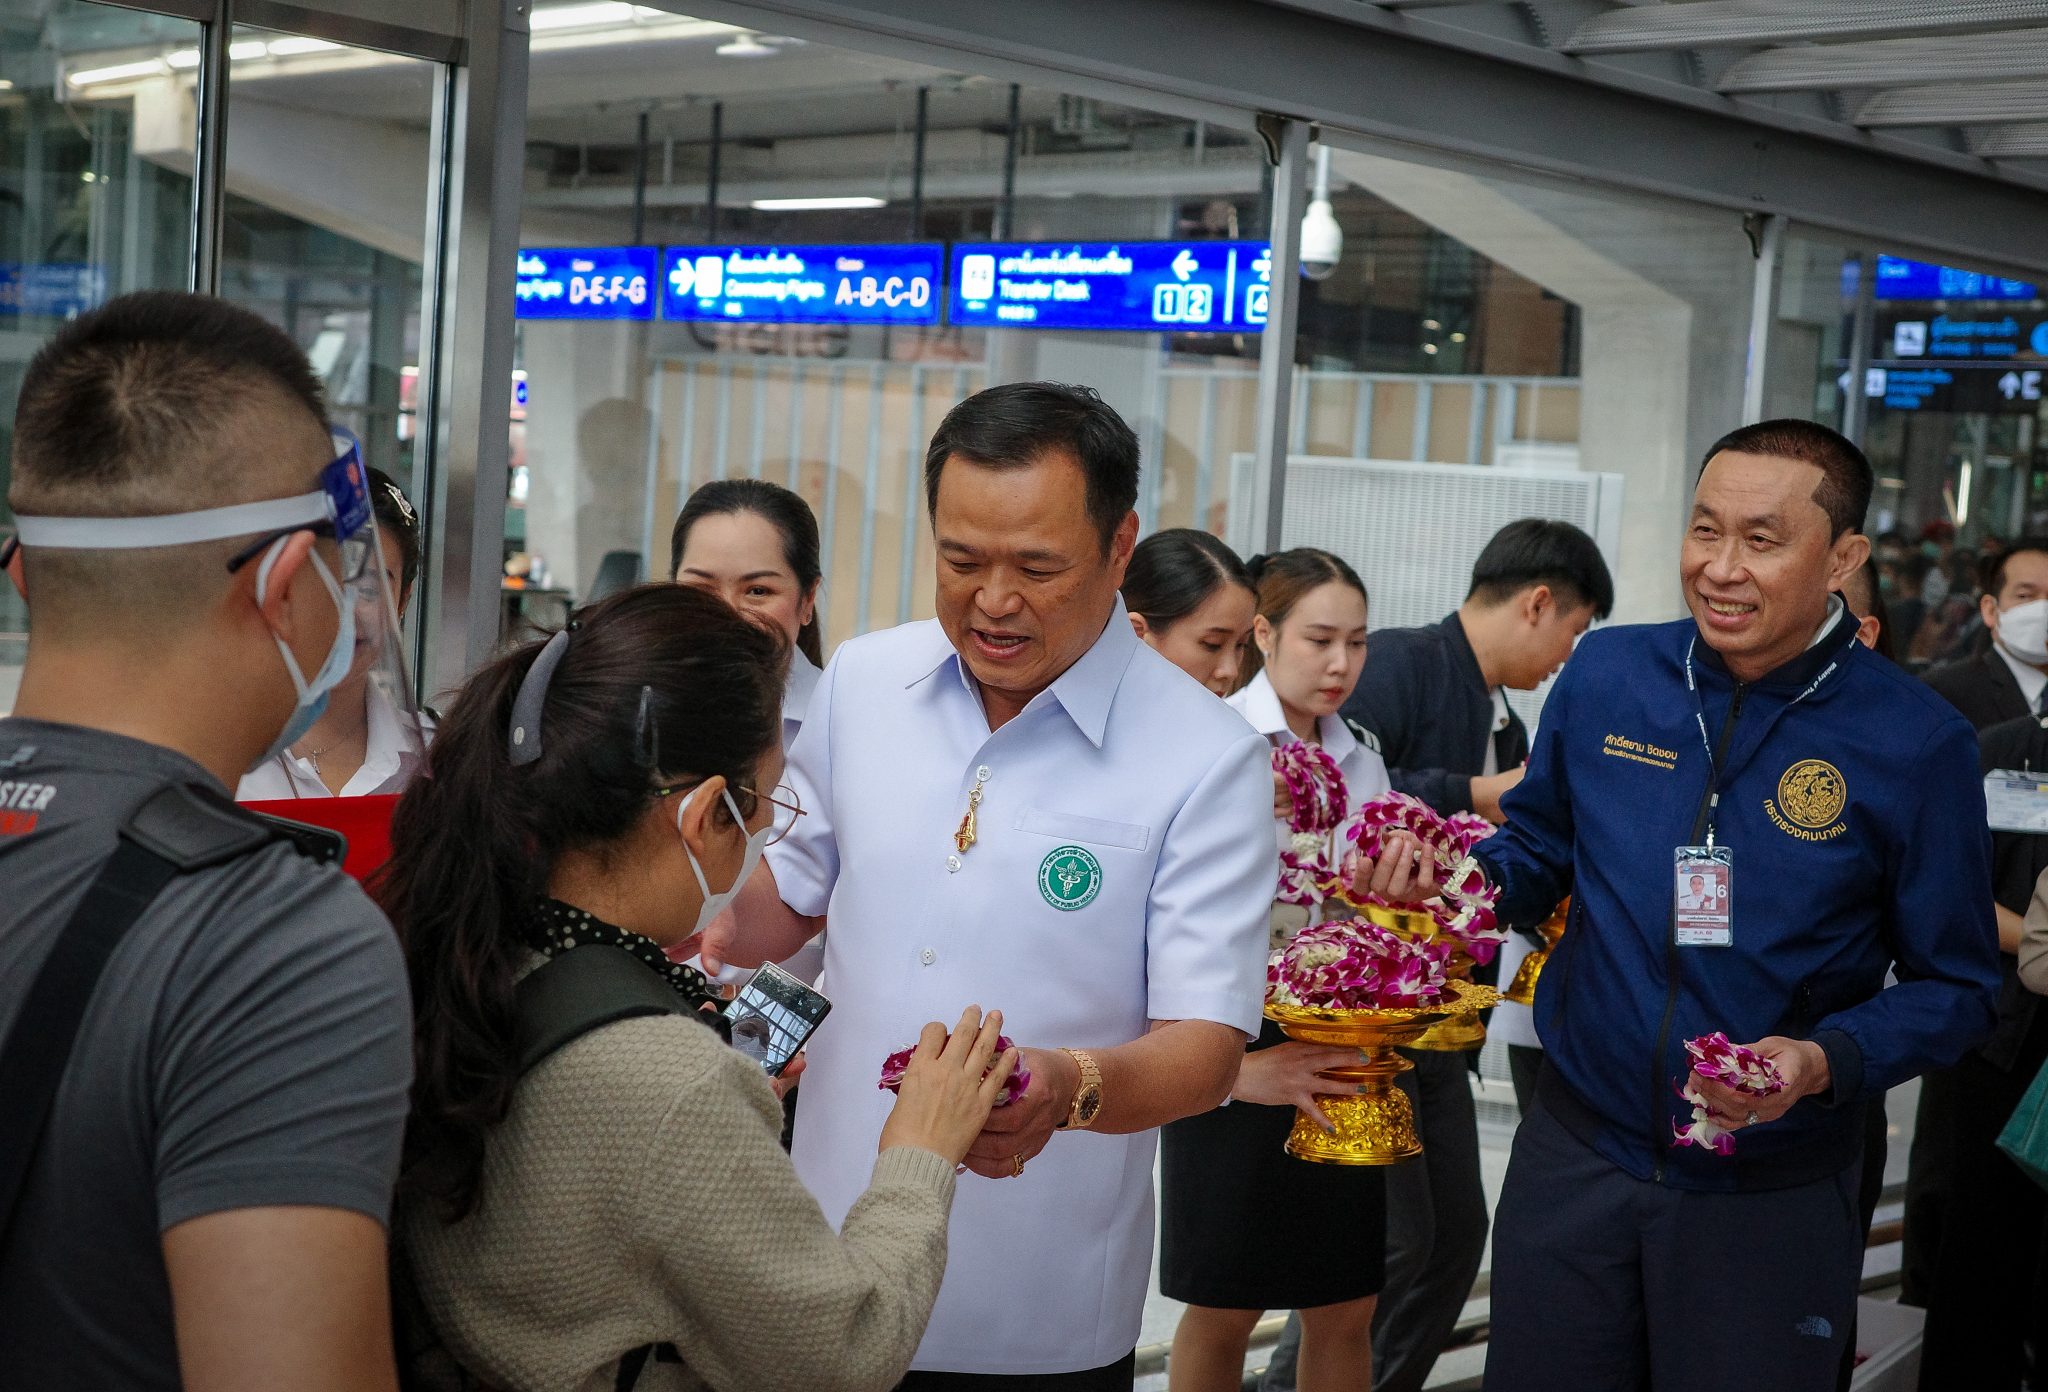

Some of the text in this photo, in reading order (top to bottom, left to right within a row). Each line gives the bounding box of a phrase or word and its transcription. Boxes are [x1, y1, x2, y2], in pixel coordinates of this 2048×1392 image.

[569, 276, 647, 306] D-E-F-G
[834, 277, 931, 308] A-B-C-D
[1162, 290, 1173, 315] 1
[1188, 289, 1204, 316] 2
[1647, 743, 1678, 761] ชิดชอบ
[1763, 798, 1848, 842] กระทรวงคมนาคม
[1716, 884, 1728, 898] 6
